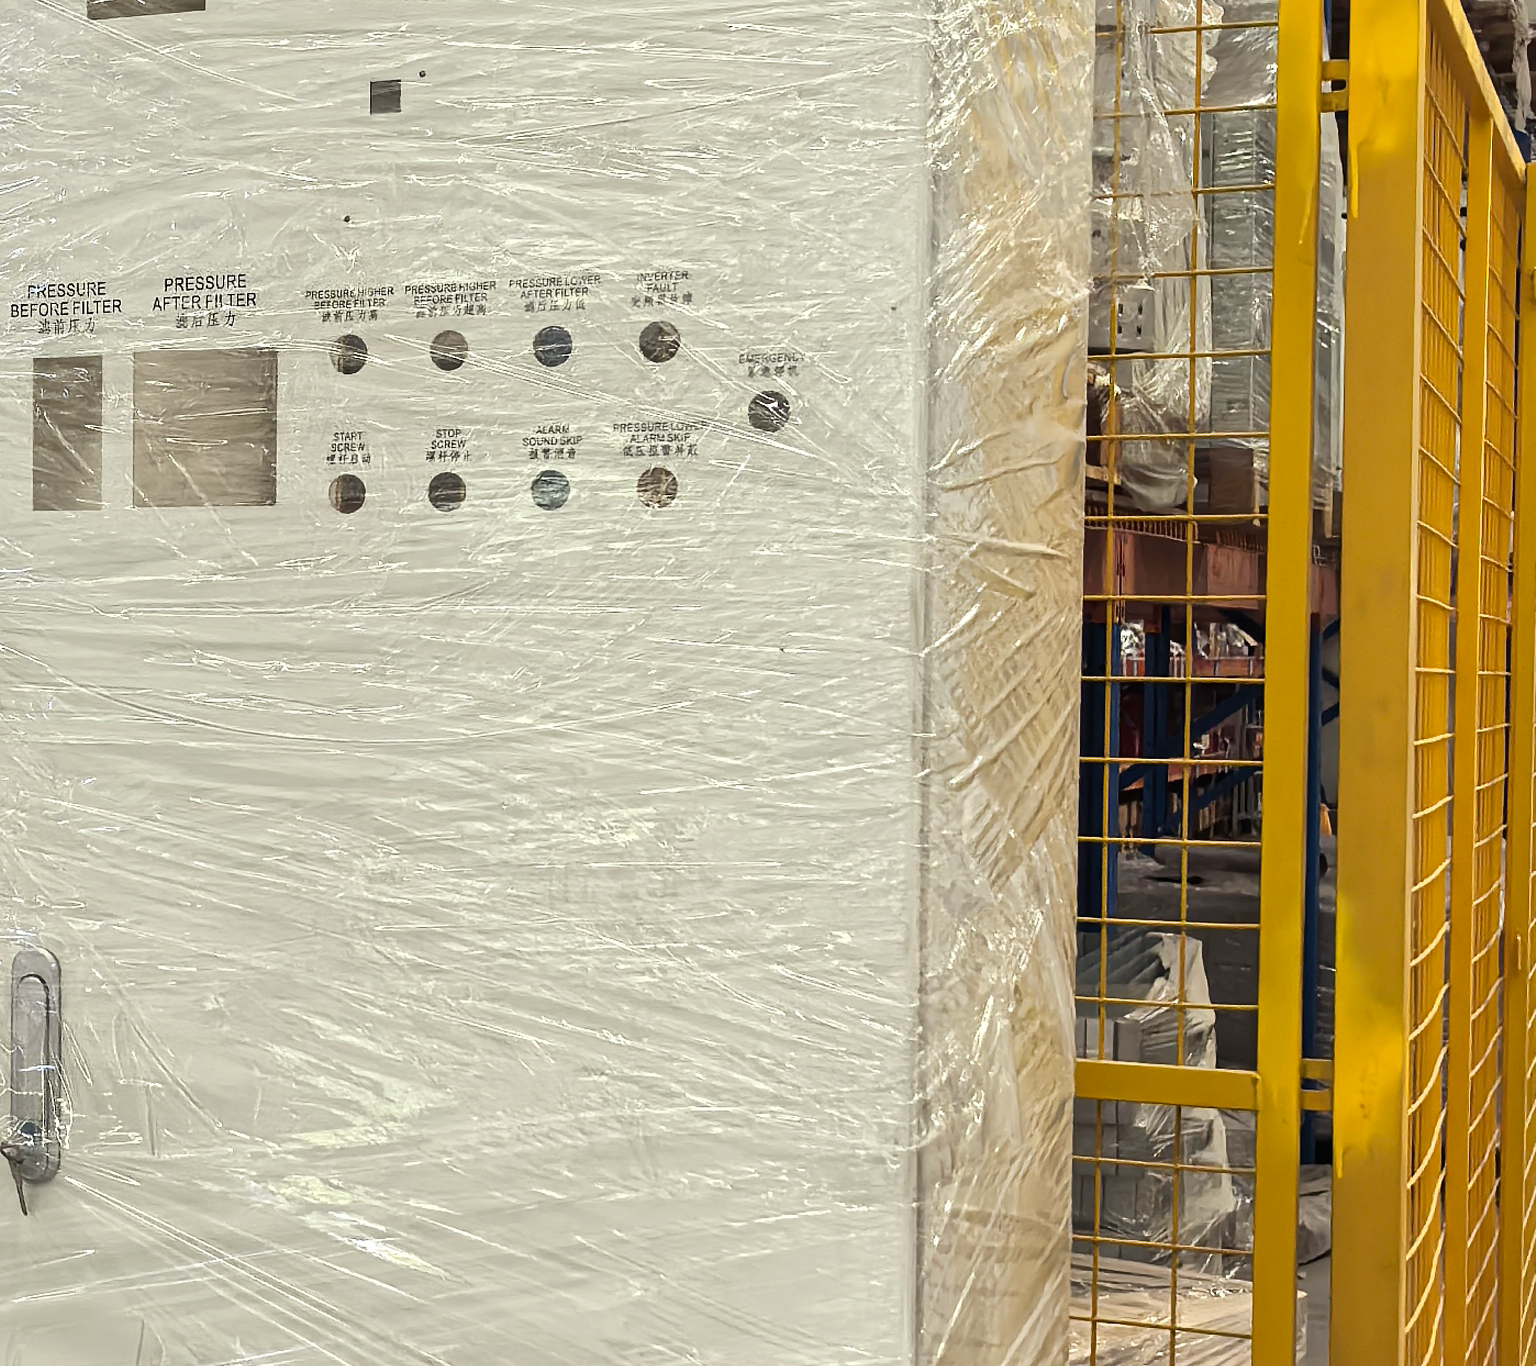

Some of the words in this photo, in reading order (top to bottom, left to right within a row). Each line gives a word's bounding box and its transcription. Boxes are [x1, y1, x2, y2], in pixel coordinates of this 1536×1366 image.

[636, 270, 689, 282] INVERTER
[163, 273, 247, 292] PRESSURE
[404, 283, 457, 295] PRESSURE
[458, 280, 497, 292] HIGHER
[509, 276, 563, 289] PRESSURE
[646, 282, 678, 293] FAULT
[27, 281, 107, 299] PRESSURE
[305, 289, 356, 300] PRESSURE
[357, 286, 394, 298] HIGHER
[520, 288, 553, 299] AFTER
[555, 287, 589, 297] FILTER
[153, 294, 201, 312] AFTER
[205, 292, 257, 310] FILTER
[314, 299, 351, 310] BEFORE
[353, 298, 386, 308] FILTER
[414, 294, 452, 305] BEFORE
[455, 292, 488, 304] FILTER
[10, 301, 69, 318] BEFORE
[72, 299, 122, 316] FILTER
[435, 428, 462, 439] STOP
[536, 424, 570, 434] ALARM
[612, 422, 669, 433] PRESSURE
[333, 431, 363, 441] START
[522, 436, 558, 446] SOUND
[560, 435, 583, 446] SKIP
[629, 434, 665, 443] ALARM
[667, 433, 691, 442] SKIP
[331, 442, 365, 452] SCREW
[431, 439, 467, 450] SCREW
